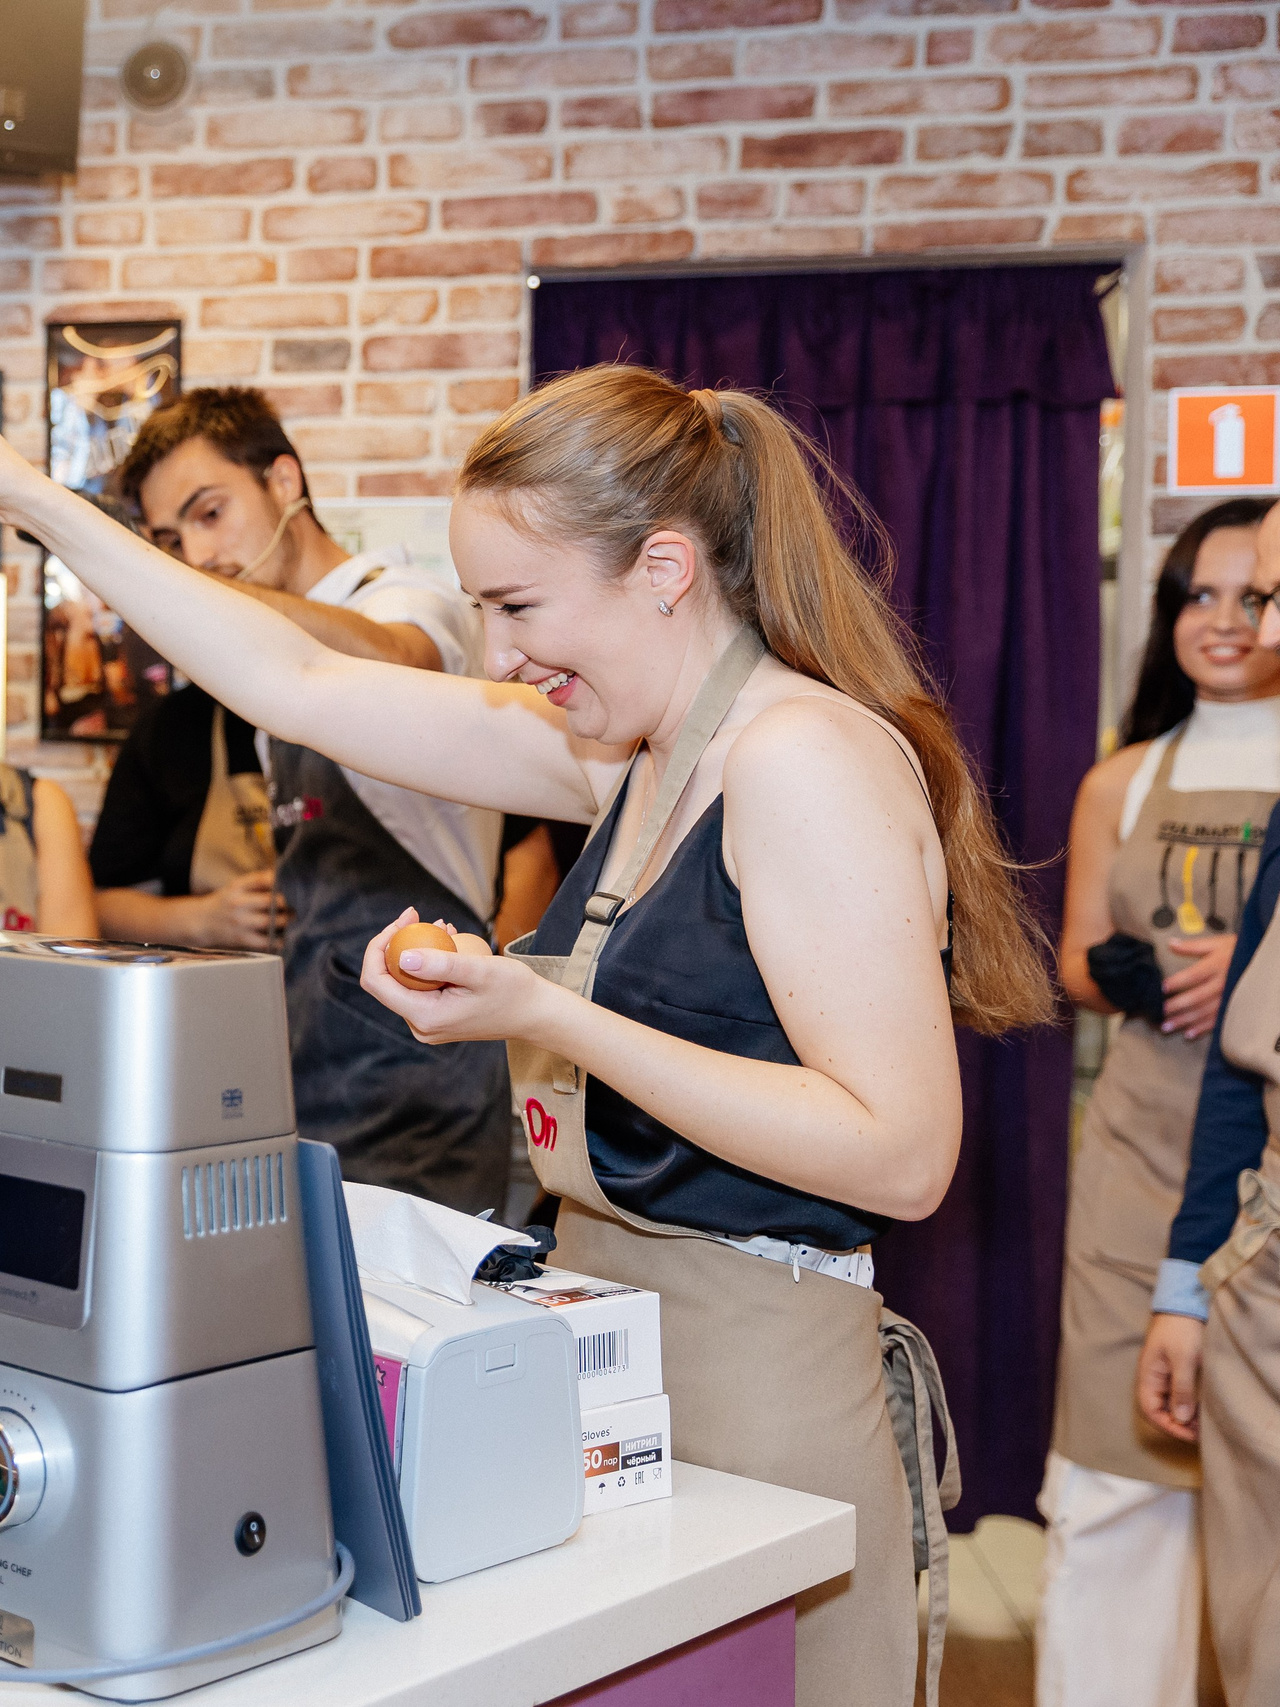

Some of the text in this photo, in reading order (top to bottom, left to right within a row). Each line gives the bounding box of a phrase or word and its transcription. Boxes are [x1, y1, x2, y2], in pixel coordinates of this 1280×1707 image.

[625, 1435, 658, 1452] НИТРИЛ
[626, 1451, 657, 1467] чёрный
[10, 1562, 32, 1577] CHEF
